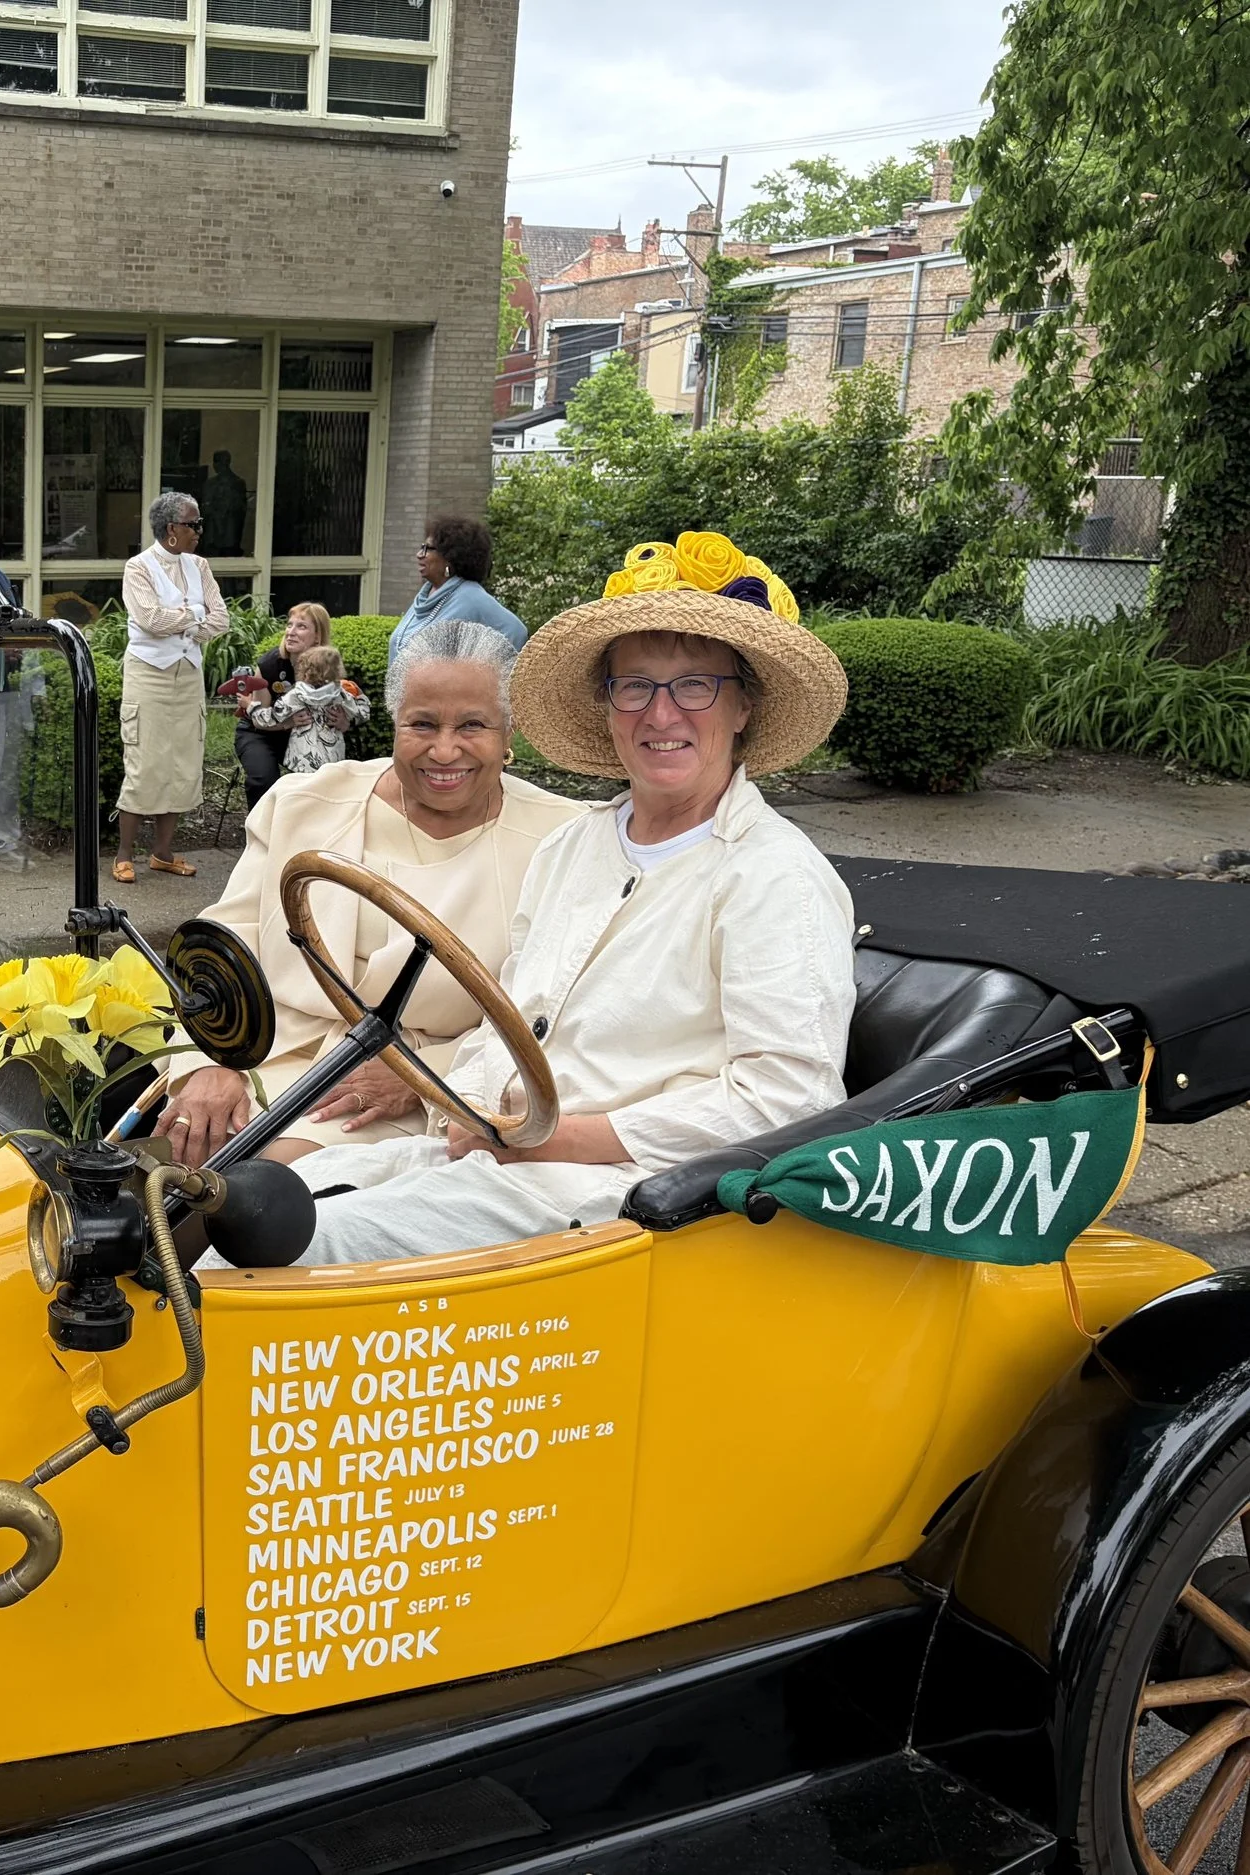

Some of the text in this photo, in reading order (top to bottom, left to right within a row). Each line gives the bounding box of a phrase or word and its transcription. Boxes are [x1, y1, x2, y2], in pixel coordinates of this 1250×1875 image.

[821, 1131, 1090, 1236] SAXON
[251, 1315, 570, 1377] NEW YORK APRIL 6 1916
[250, 1350, 600, 1417] NEW ORLEANS APRIL 27
[250, 1393, 562, 1457] LOS ANGELES JUNE 5
[245, 1421, 615, 1497] SAN FRANCISCO JUNE 28
[245, 1483, 466, 1536] SEATTLE JULY 13
[248, 1504, 558, 1574] MINNEAPOLIS SEPT. 1
[245, 1554, 483, 1612] CHICAGO SEPT. 12
[247, 1591, 472, 1651] DETROIT SEPT. 15
[246, 1626, 441, 1687] NEW YORK
